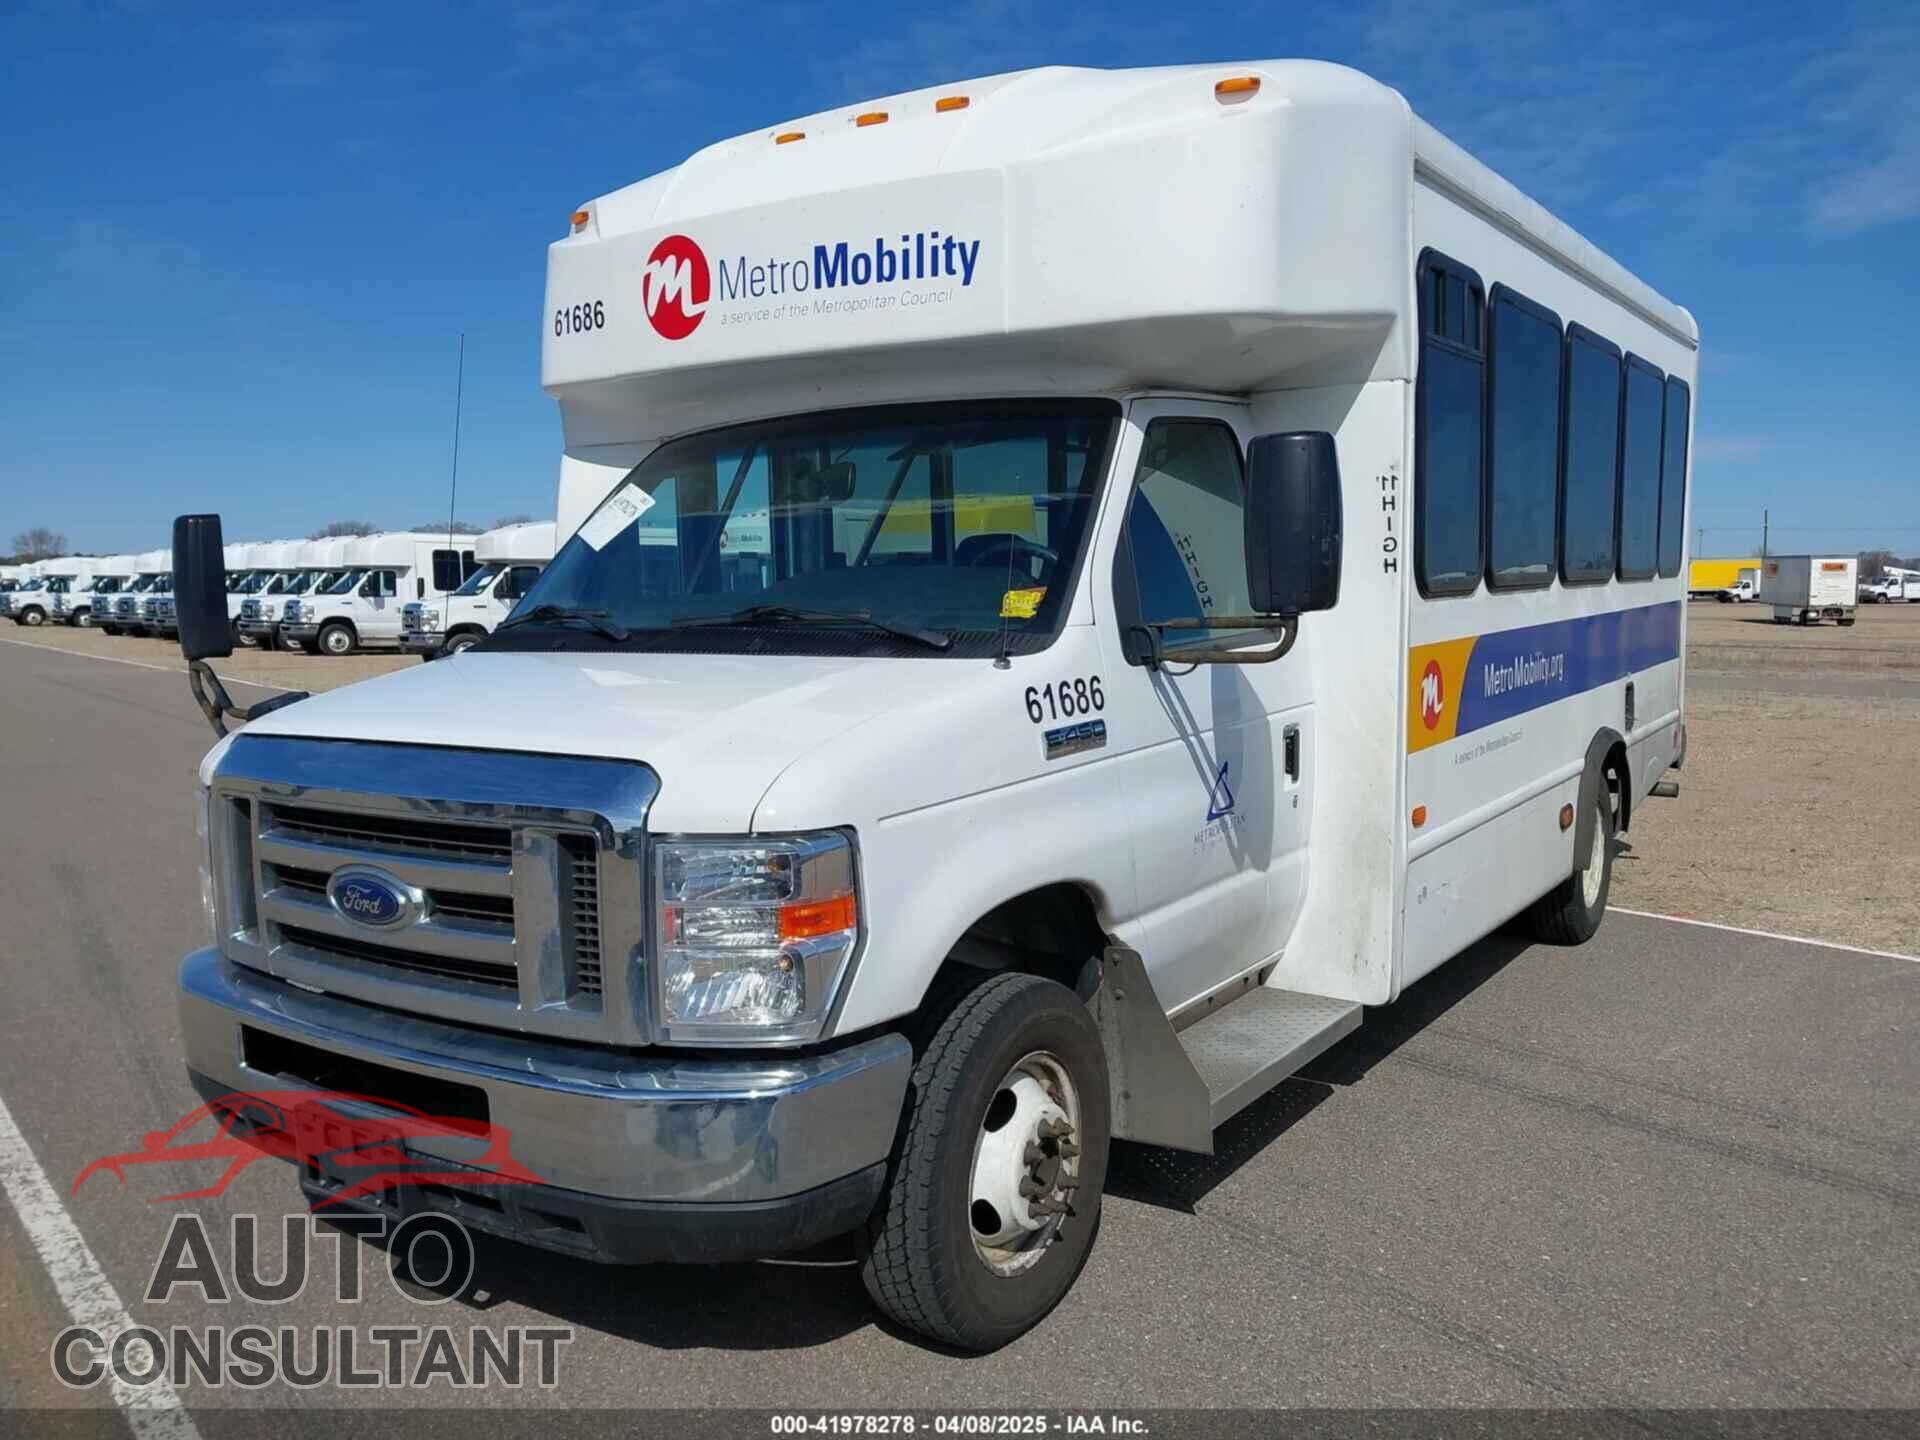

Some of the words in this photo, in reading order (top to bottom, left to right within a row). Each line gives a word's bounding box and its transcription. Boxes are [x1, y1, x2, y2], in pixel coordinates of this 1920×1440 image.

[718, 231, 981, 301] MetroMobility
[554, 300, 606, 337] 61686
[720, 314, 727, 325] a
[730, 308, 770, 326] service
[773, 303, 786, 320] of
[789, 301, 809, 318] the
[813, 295, 896, 316] Metropolitan
[900, 288, 954, 306] Council
[1025, 676, 1105, 724] 61686
[344, 884, 381, 914] Ford
